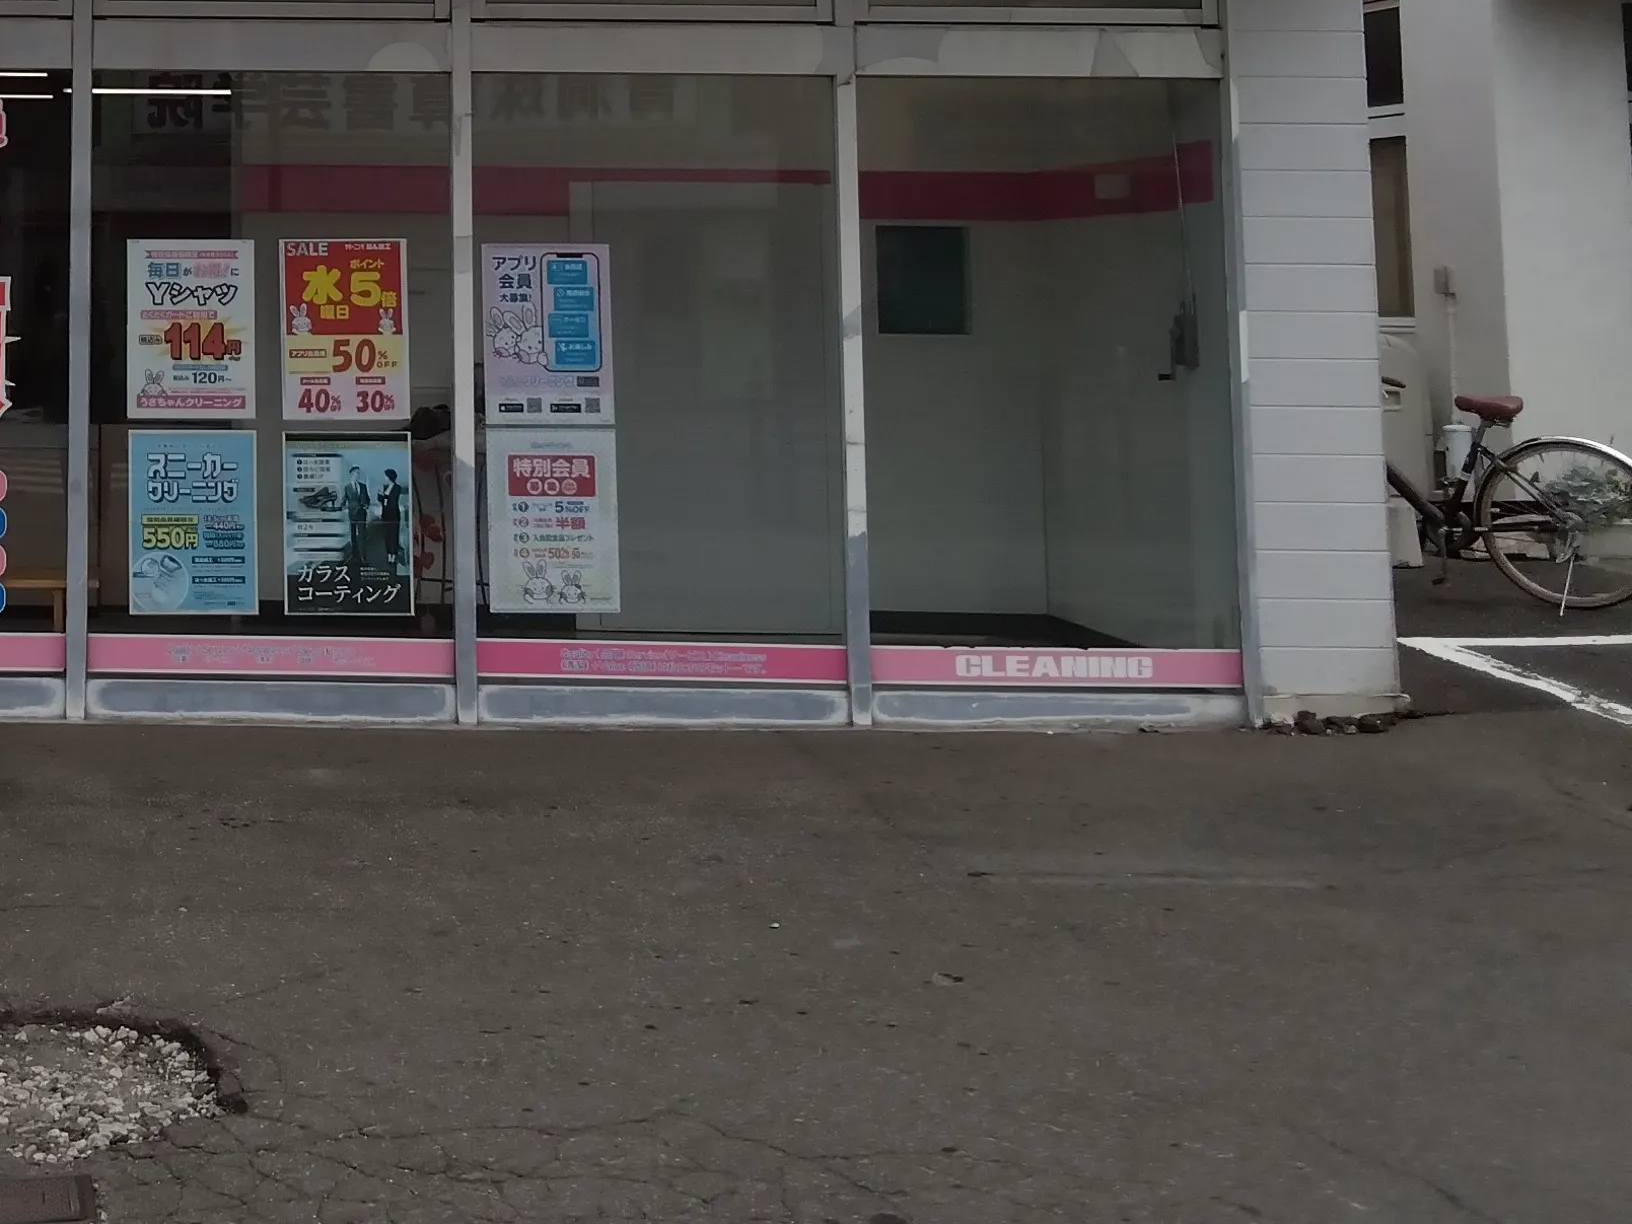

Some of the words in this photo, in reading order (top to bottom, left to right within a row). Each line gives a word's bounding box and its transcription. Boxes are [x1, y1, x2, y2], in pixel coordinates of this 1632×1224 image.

[287, 242, 329, 256] SALE
[350, 259, 385, 269] ポイント
[492, 255, 537, 271] アプリ
[302, 265, 343, 304] 水
[498, 273, 533, 289] 会員
[145, 281, 239, 306] Yシャツ
[332, 338, 376, 373] 50
[298, 388, 330, 414] 40
[356, 389, 384, 413] 30
[146, 451, 239, 479] スニーカー
[513, 457, 591, 478] 特別会員
[146, 479, 240, 504] クリーニング
[141, 526, 200, 550] 550円
[297, 564, 351, 583] ガラス
[297, 583, 402, 604] コーティング
[955, 654, 1153, 679] CLEANING
